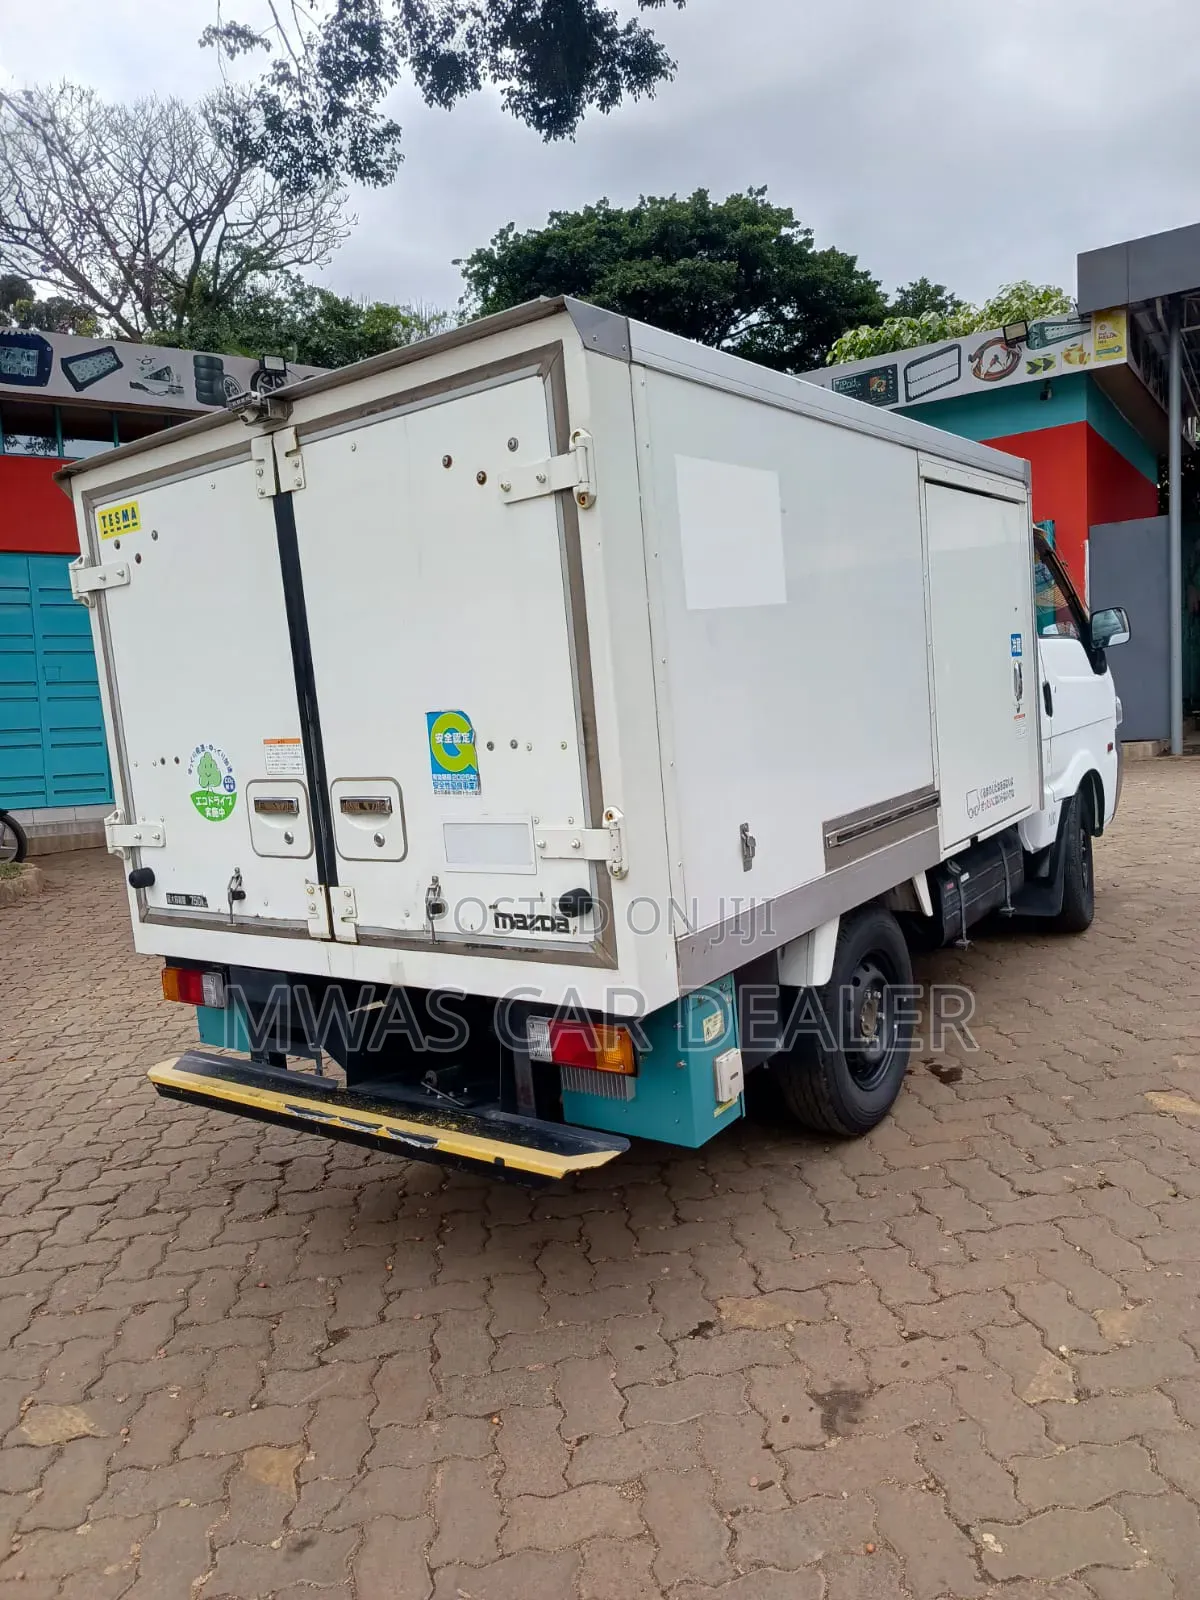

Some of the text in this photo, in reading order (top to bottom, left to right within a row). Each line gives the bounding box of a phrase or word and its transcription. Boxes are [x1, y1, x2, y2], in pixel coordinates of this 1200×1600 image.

[101, 506, 137, 529] TESMA
[434, 732, 471, 745] 安全認定
[494, 912, 570, 934] mazda
